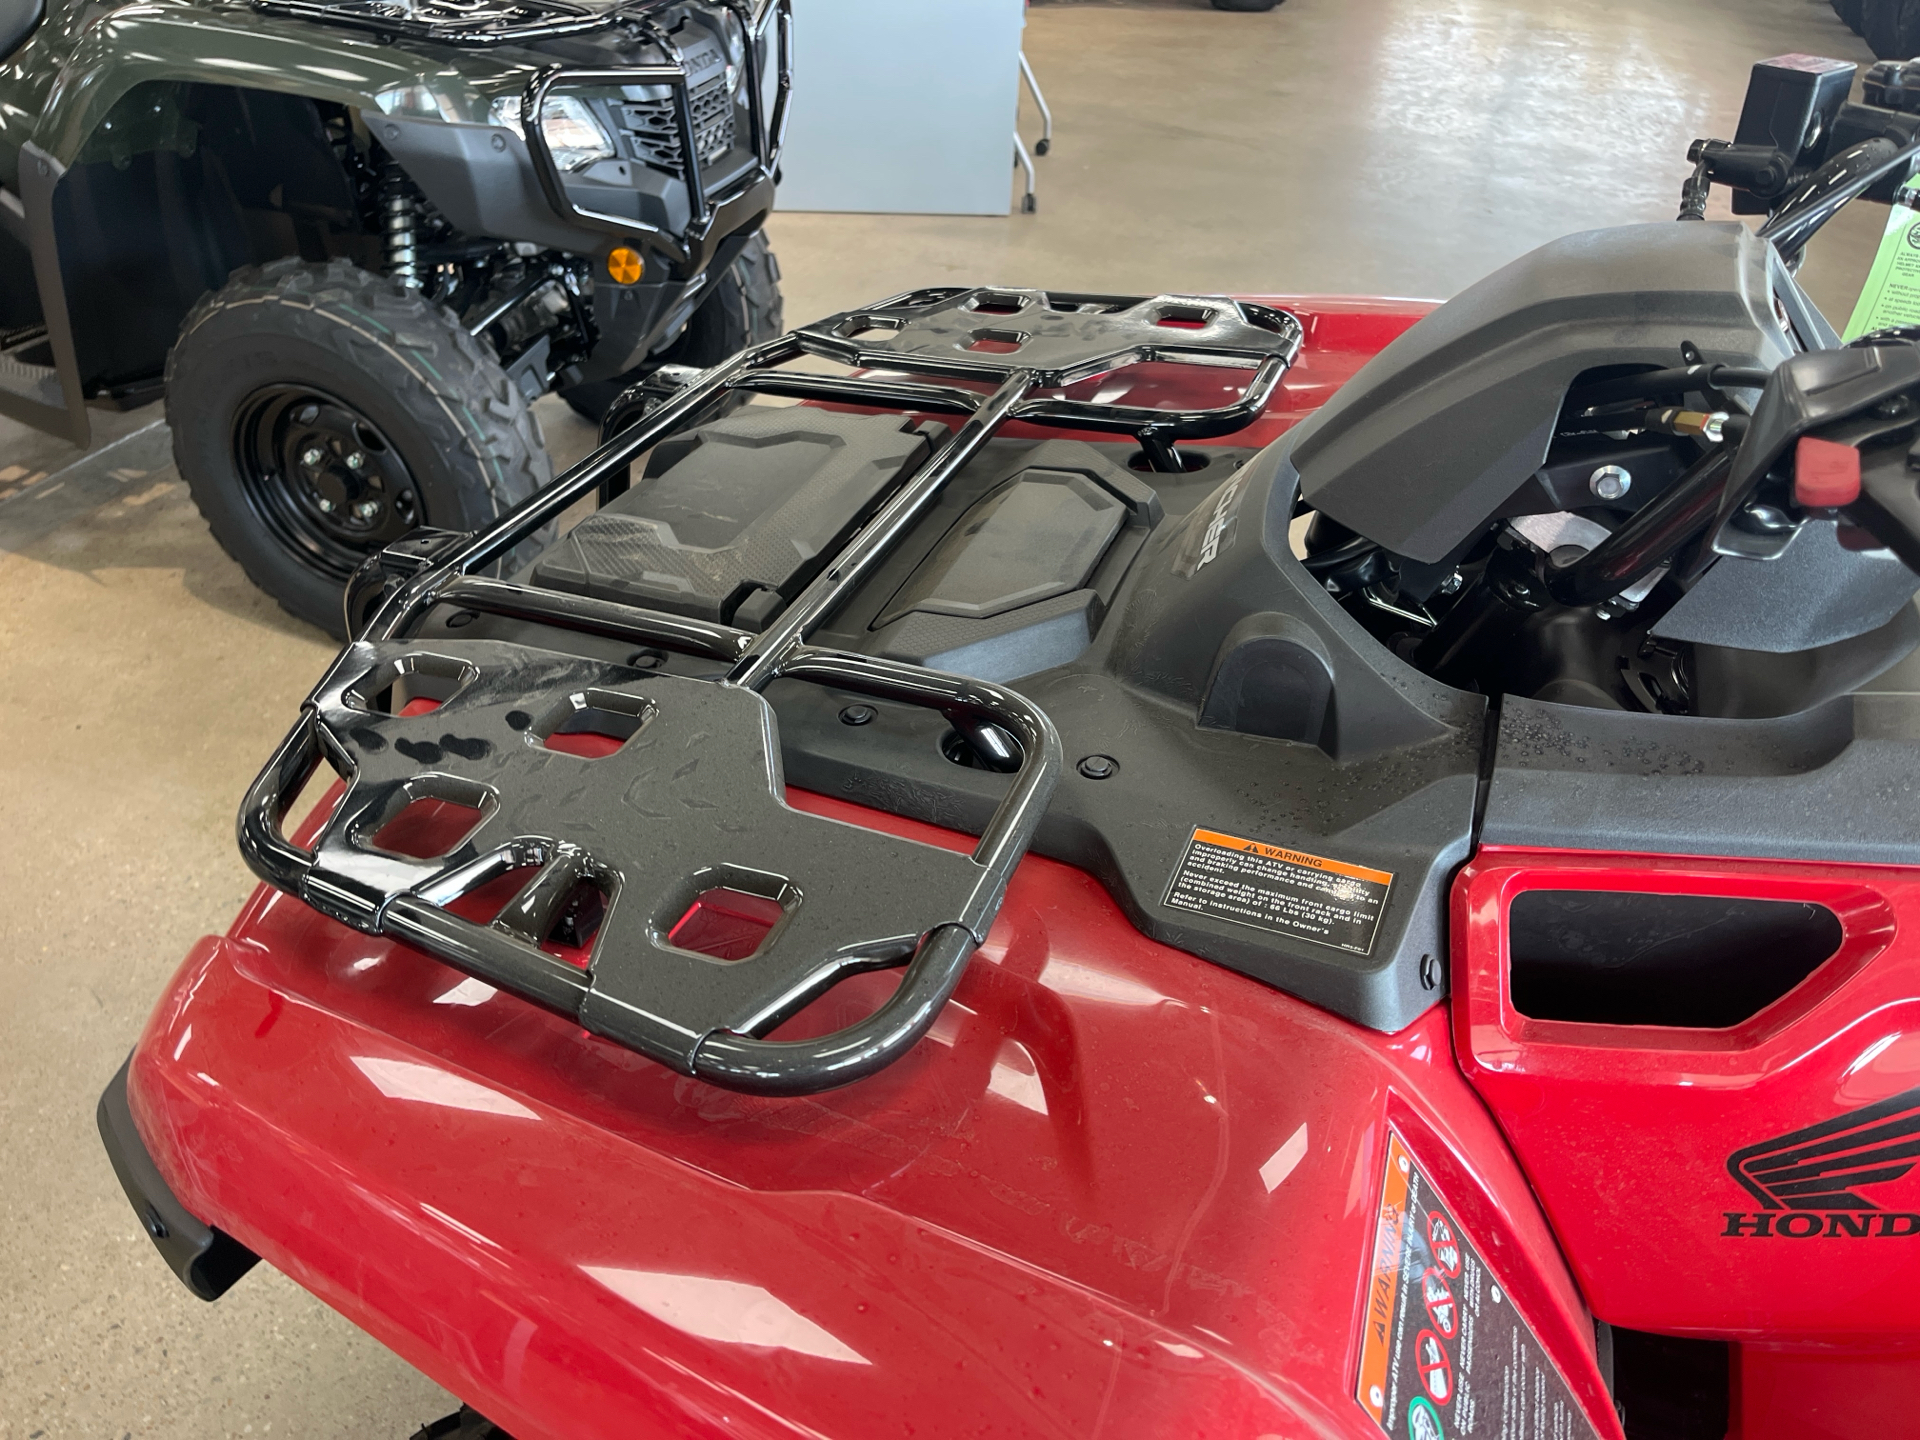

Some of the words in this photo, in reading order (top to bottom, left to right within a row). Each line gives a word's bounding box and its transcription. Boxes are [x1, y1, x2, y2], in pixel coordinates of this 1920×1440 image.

[1187, 861, 1225, 874] accident.
[1191, 849, 1237, 865] improperly
[1256, 865, 1288, 876] change
[1332, 883, 1371, 896] stility
[1194, 844, 1245, 860] Overloading
[1247, 855, 1263, 864] this
[1265, 861, 1284, 869] ATV
[1297, 868, 1333, 882] carrying
[1335, 877, 1362, 888] cargo
[1207, 859, 1239, 871] braking
[1240, 868, 1295, 885] performance
[1297, 880, 1313, 889] and
[1264, 847, 1323, 868] WARNING
[1170, 897, 1204, 911] Manual.
[1178, 882, 1192, 890] the
[1193, 886, 1226, 898] storage
[1228, 894, 1250, 905] area)
[1252, 900, 1262, 908] of
[1282, 907, 1299, 916] Lbs
[1301, 911, 1316, 920] (30
[1318, 915, 1335, 925] kg).
[1180, 876, 1225, 891] (combined
[1226, 887, 1256, 899] weight
[1270, 898, 1285, 906] the
[1287, 902, 1309, 912] front
[1311, 908, 1331, 917] rack
[1333, 914, 1351, 922] and
[1183, 870, 1208, 880] Never
[1209, 877, 1240, 888] exceed
[1241, 884, 1256, 892] the
[1257, 889, 1299, 903] maximum
[1301, 898, 1324, 909] front
[1325, 905, 1351, 915] cargo
[1353, 911, 1375, 921] limit
[1173, 891, 1197, 902] Refer
[1199, 897, 1208, 905] to
[1209, 900, 1262, 918] instructions
[1264, 913, 1273, 921] in
[1275, 916, 1291, 925] the
[1292, 920, 1329, 935] Owner's
[1411, 1172, 1420, 1203] DEATH
[1410, 1202, 1416, 1213] or
[1407, 1212, 1416, 1246] INJURY
[1720, 1212, 1920, 1238] HOND
[1373, 1204, 1399, 1318] WARNING
[1402, 1245, 1412, 1284] SEVERE
[1402, 1283, 1408, 1294] in
[1399, 1294, 1407, 1321] result
[1459, 1336, 1467, 1369] NEVER
[1466, 1315, 1474, 1375] PASSENGERS
[1457, 1372, 1465, 1393] USE
[1386, 1382, 1398, 1430] Improper
[1462, 1381, 1471, 1418] PUBLIC
[1460, 1419, 1467, 1436] ON
